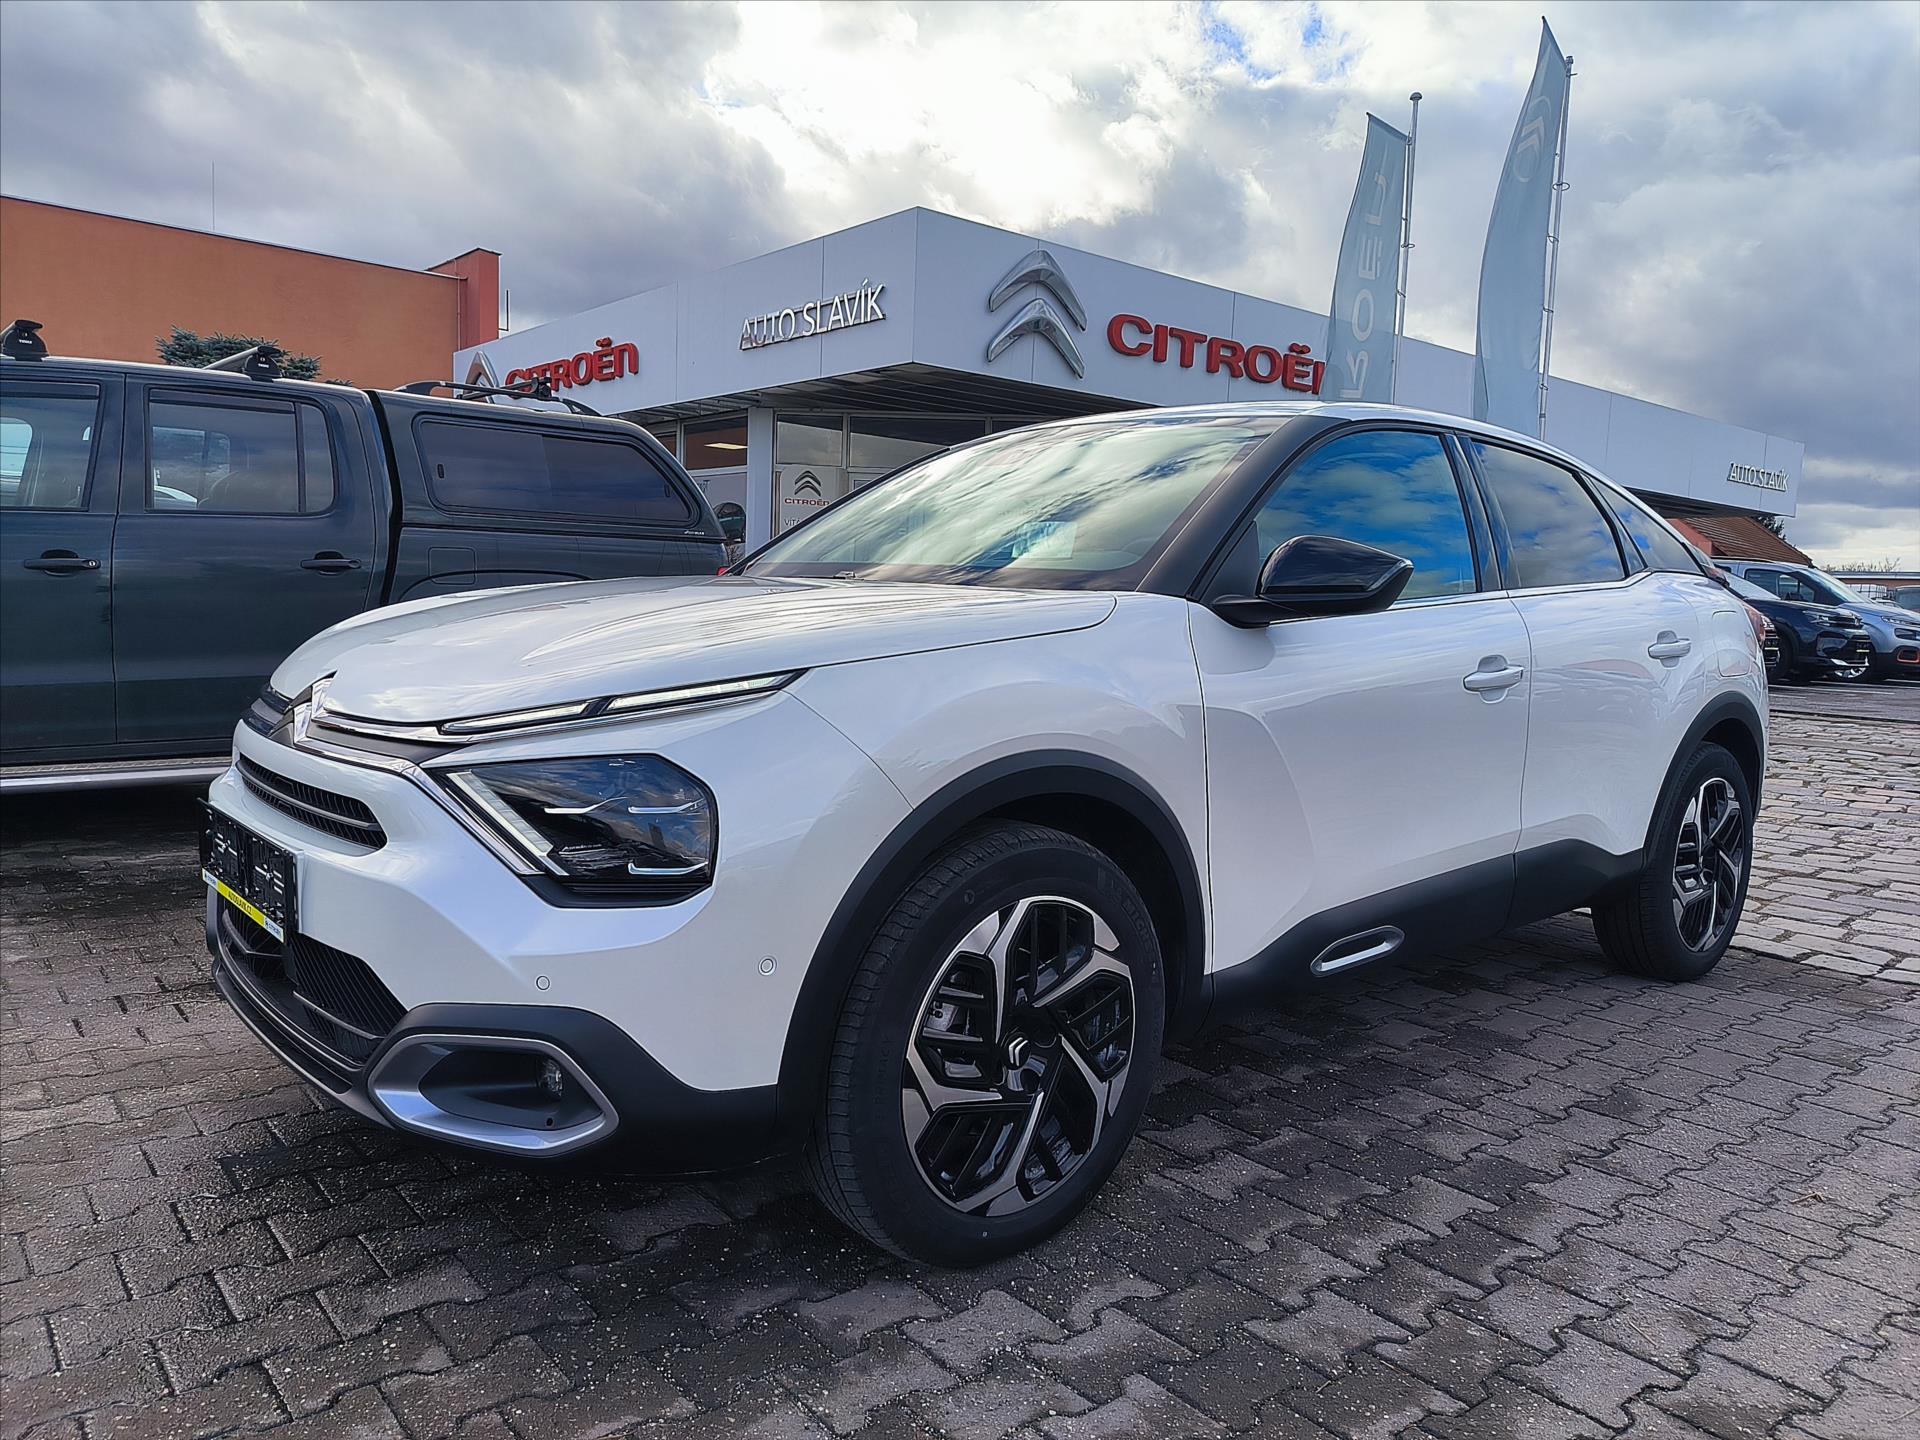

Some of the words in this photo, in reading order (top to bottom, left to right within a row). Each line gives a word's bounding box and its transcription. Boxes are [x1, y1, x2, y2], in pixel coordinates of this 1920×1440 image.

[740, 308, 796, 350] AUTO
[802, 278, 886, 337] SLAVÍK
[1728, 462, 1757, 485] AUTO
[1759, 468, 1789, 491] SLAVÍK
